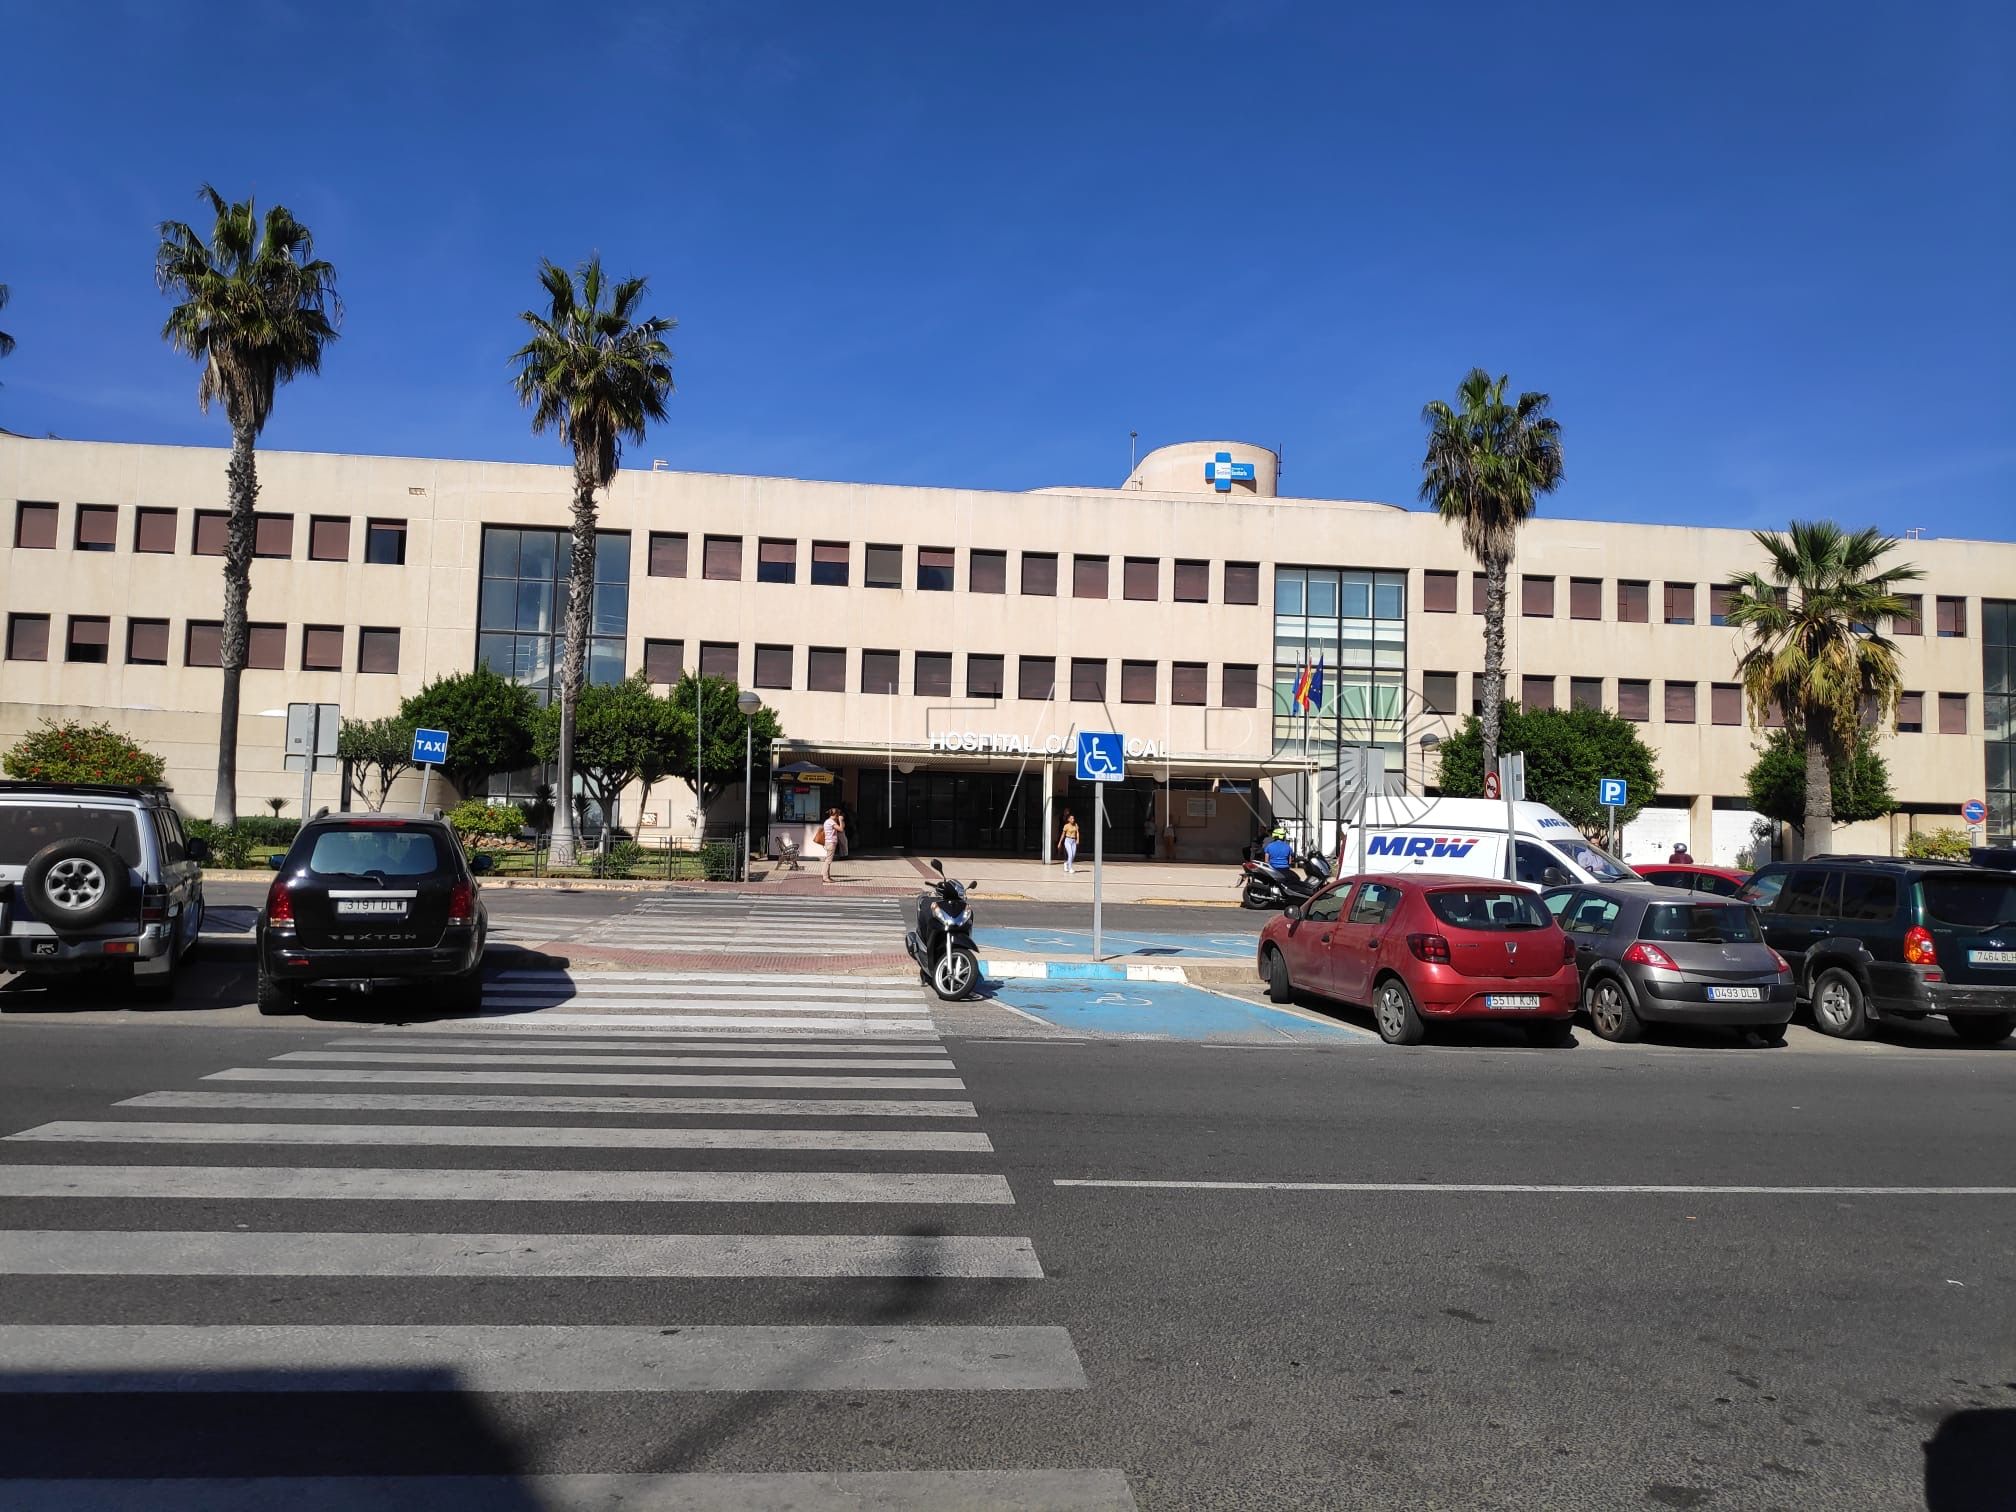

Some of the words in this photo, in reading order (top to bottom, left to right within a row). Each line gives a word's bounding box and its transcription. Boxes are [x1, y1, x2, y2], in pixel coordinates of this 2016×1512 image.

[416, 739, 446, 753] TAXI
[929, 731, 1034, 753] HOSPITAL
[1605, 782, 1621, 801] P
[1367, 836, 1480, 858] MRW
[1715, 988, 1739, 998] 0493
